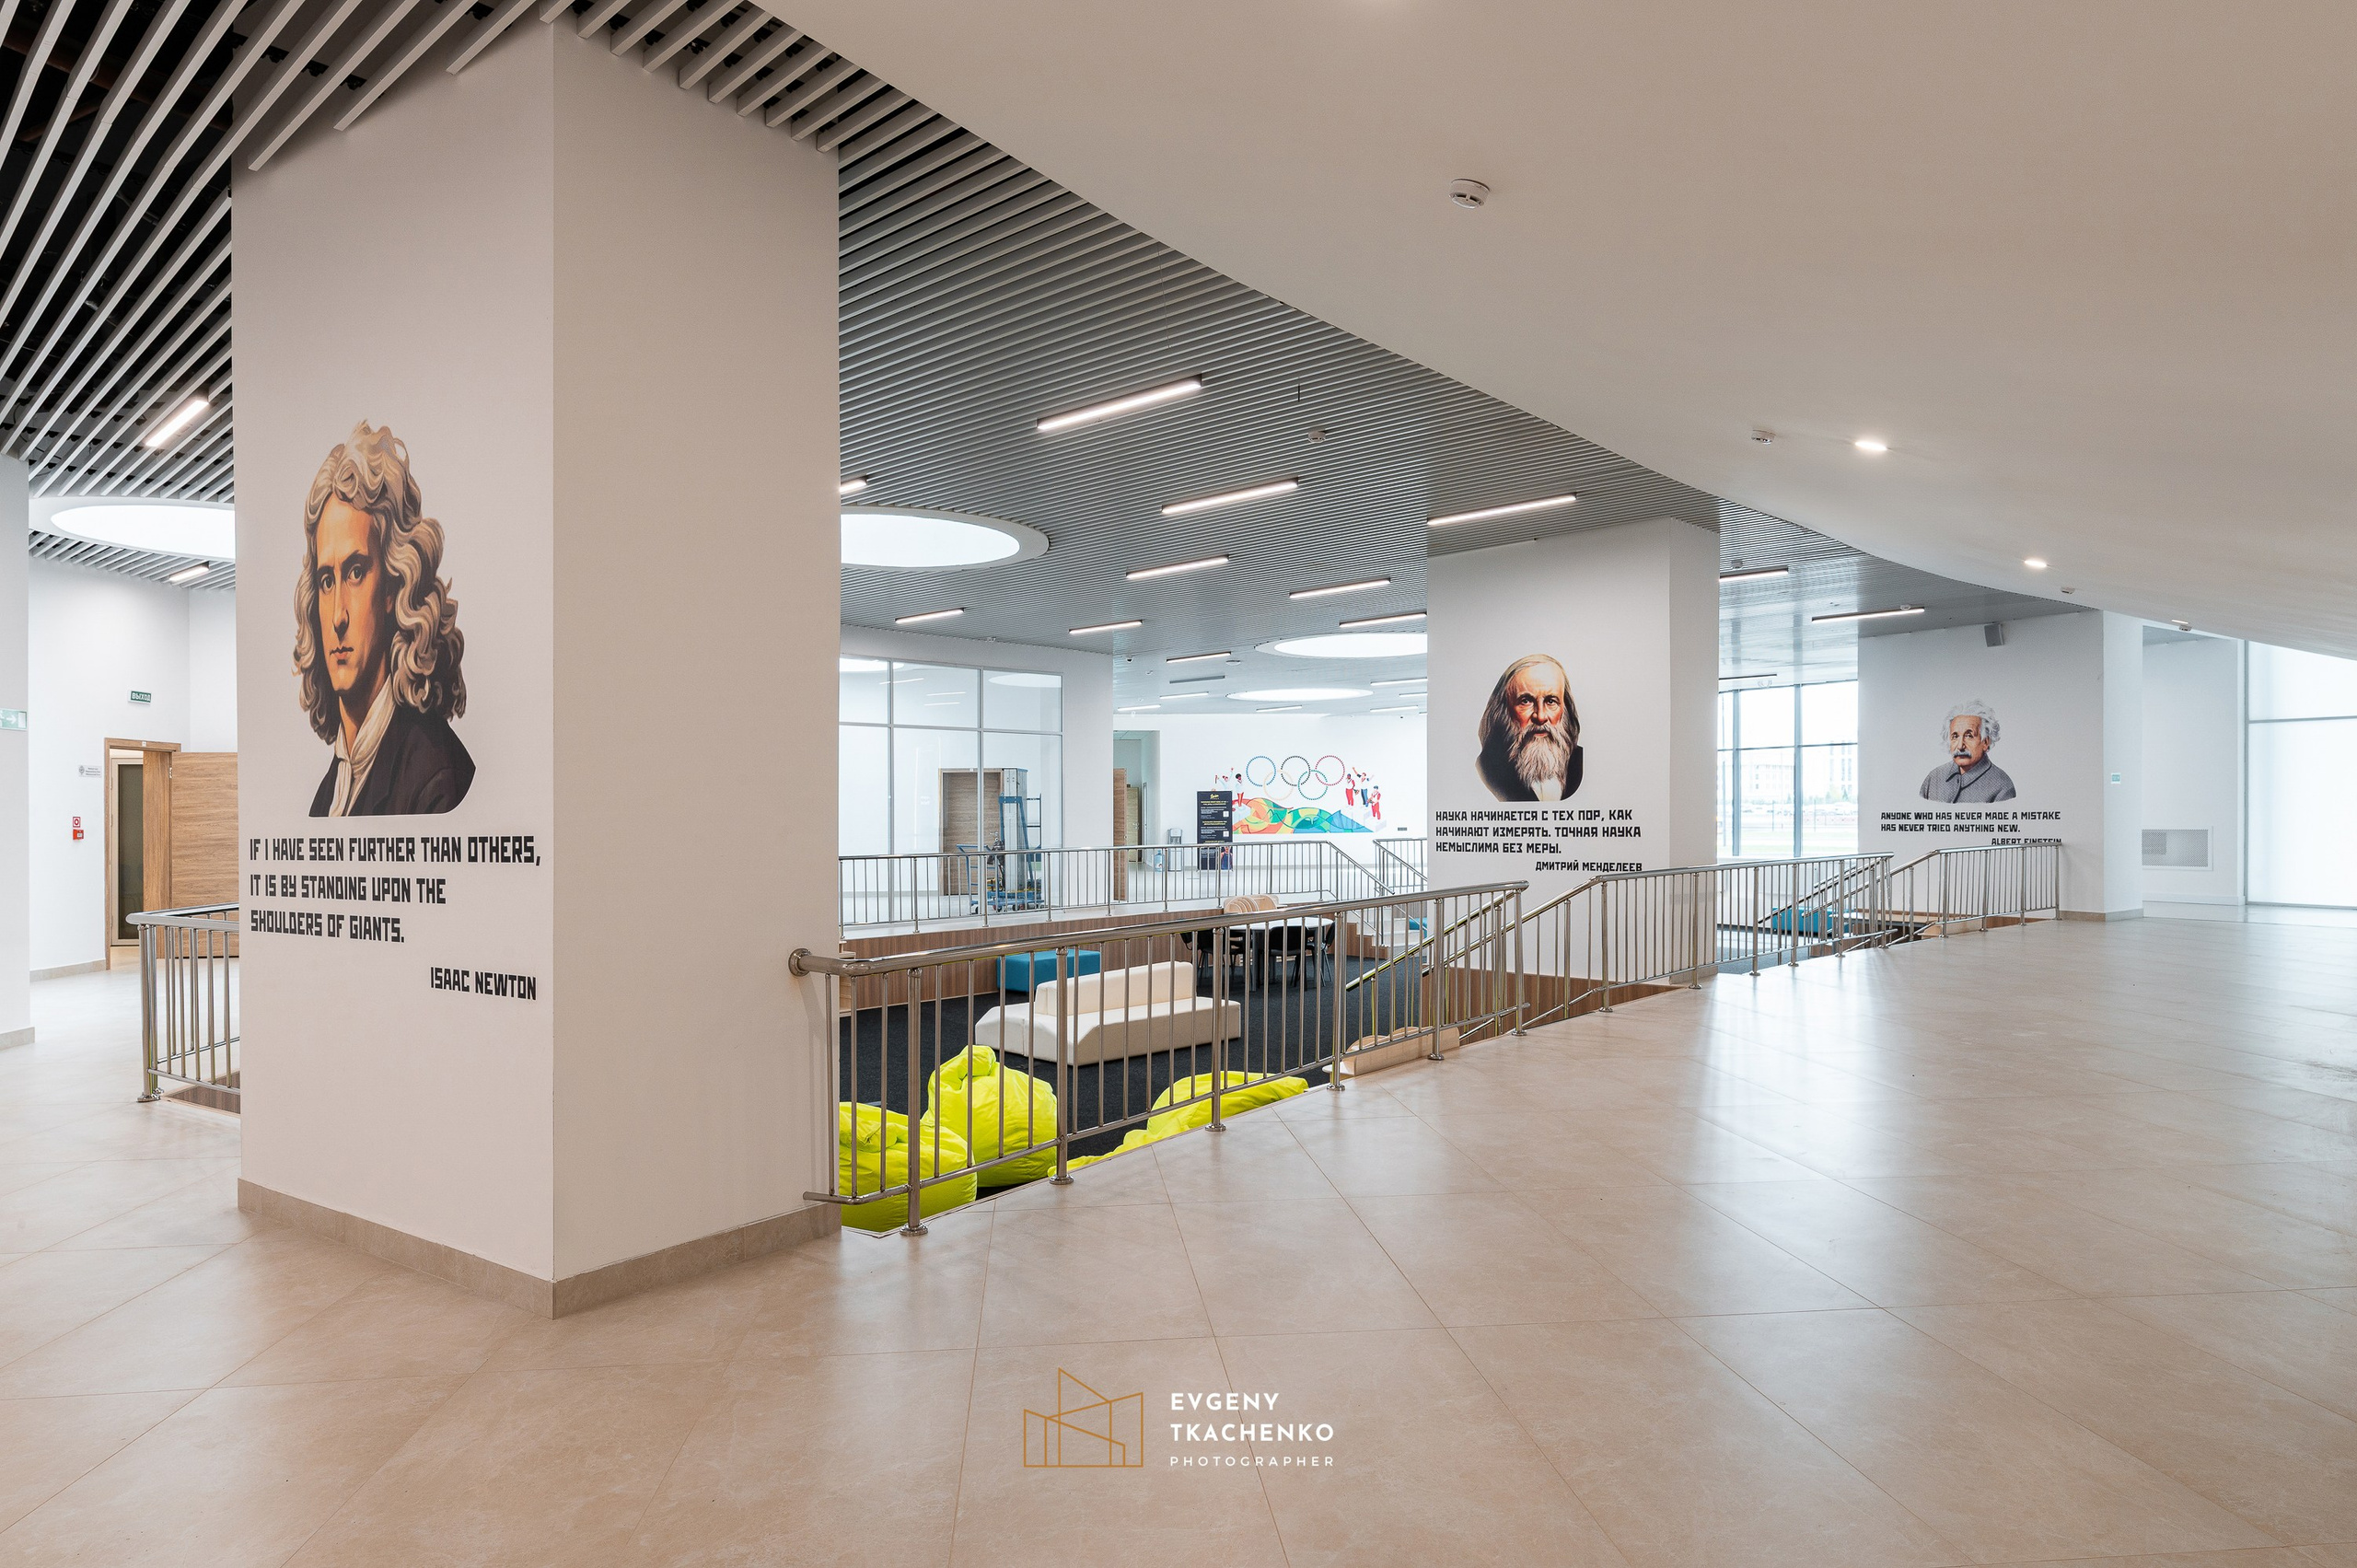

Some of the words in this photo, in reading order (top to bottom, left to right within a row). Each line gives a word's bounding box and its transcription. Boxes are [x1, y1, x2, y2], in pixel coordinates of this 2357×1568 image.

[132, 692, 150, 702] ВЫХОД
[1436, 811, 1467, 820] НАУКА
[1471, 811, 1538, 820] НАЧИНАЕТСЯ
[1542, 811, 1548, 820] С
[1552, 810, 1573, 820] ТЕХ
[1578, 810, 1604, 821] ПОР,
[1609, 809, 1632, 820] КАК
[2021, 811, 2061, 819] MISTAKE
[1436, 827, 1489, 836] НАЧИНАЮТ
[1493, 827, 1550, 837] ИЗМЕРЯТЬ.
[1555, 827, 1597, 837] ТОЧНАЯ
[1603, 827, 1641, 837] НАУКА
[1954, 824, 1994, 832] ANYTHING
[1998, 824, 2020, 832] NEW.
[250, 839, 261, 860] IF
[265, 839, 268, 860] I
[273, 839, 304, 860] HAVE
[309, 838, 343, 861] SEEN
[349, 837, 414, 862] FURTHER
[421, 837, 461, 862] THAN
[468, 836, 540, 865] OTHERS,
[1436, 842, 1499, 853] НЕМЫСЛИМА
[1503, 843, 1522, 853] БЕЗ
[1527, 843, 1562, 854] МЕРЫ.
[1536, 860, 1578, 871] ДМИТРИЙ
[1583, 863, 1643, 872] МЕНДЕЛЕЕВ
[250, 875, 261, 896] IT
[265, 875, 276, 896] IS
[281, 876, 296, 897] BY
[302, 876, 366, 900] STANDING
[372, 877, 411, 902] UPON
[416, 878, 446, 904] THE
[251, 910, 322, 936] SHOULDERS
[328, 914, 344, 937] OF
[350, 915, 404, 943] GIANTS.
[431, 967, 470, 992] ISAAC
[475, 971, 536, 1000] NEWTON
